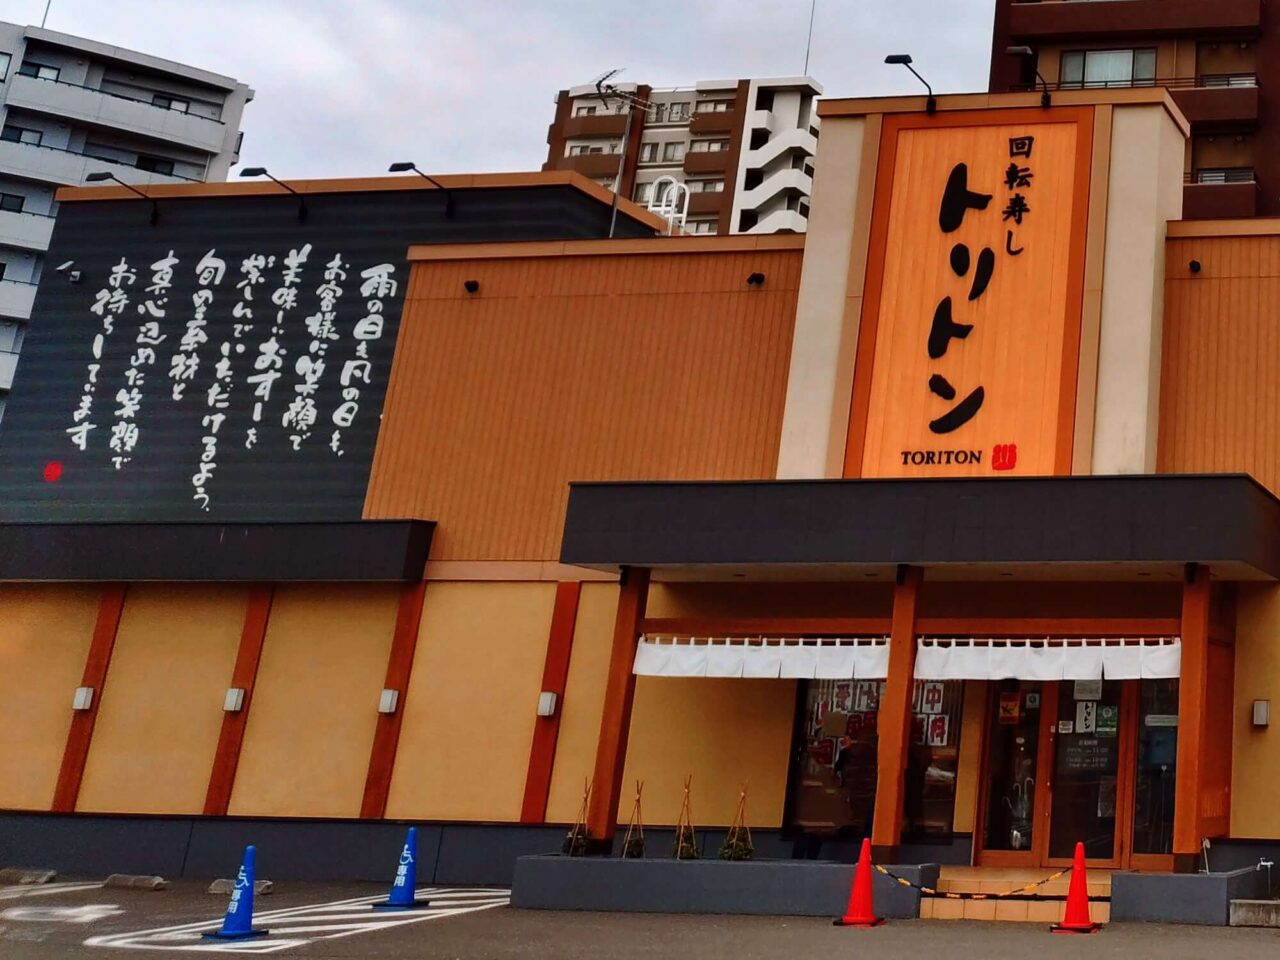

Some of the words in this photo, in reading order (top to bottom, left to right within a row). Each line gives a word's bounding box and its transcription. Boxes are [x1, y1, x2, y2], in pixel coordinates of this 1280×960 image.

[1002, 135, 1035, 256] 回転寿し
[927, 162, 995, 434] トリトン
[282, 252, 350, 451] お客様に笑顔で
[901, 450, 983, 466] TORITON
[227, 889, 243, 914] 専用
[394, 865, 408, 887] 専用
